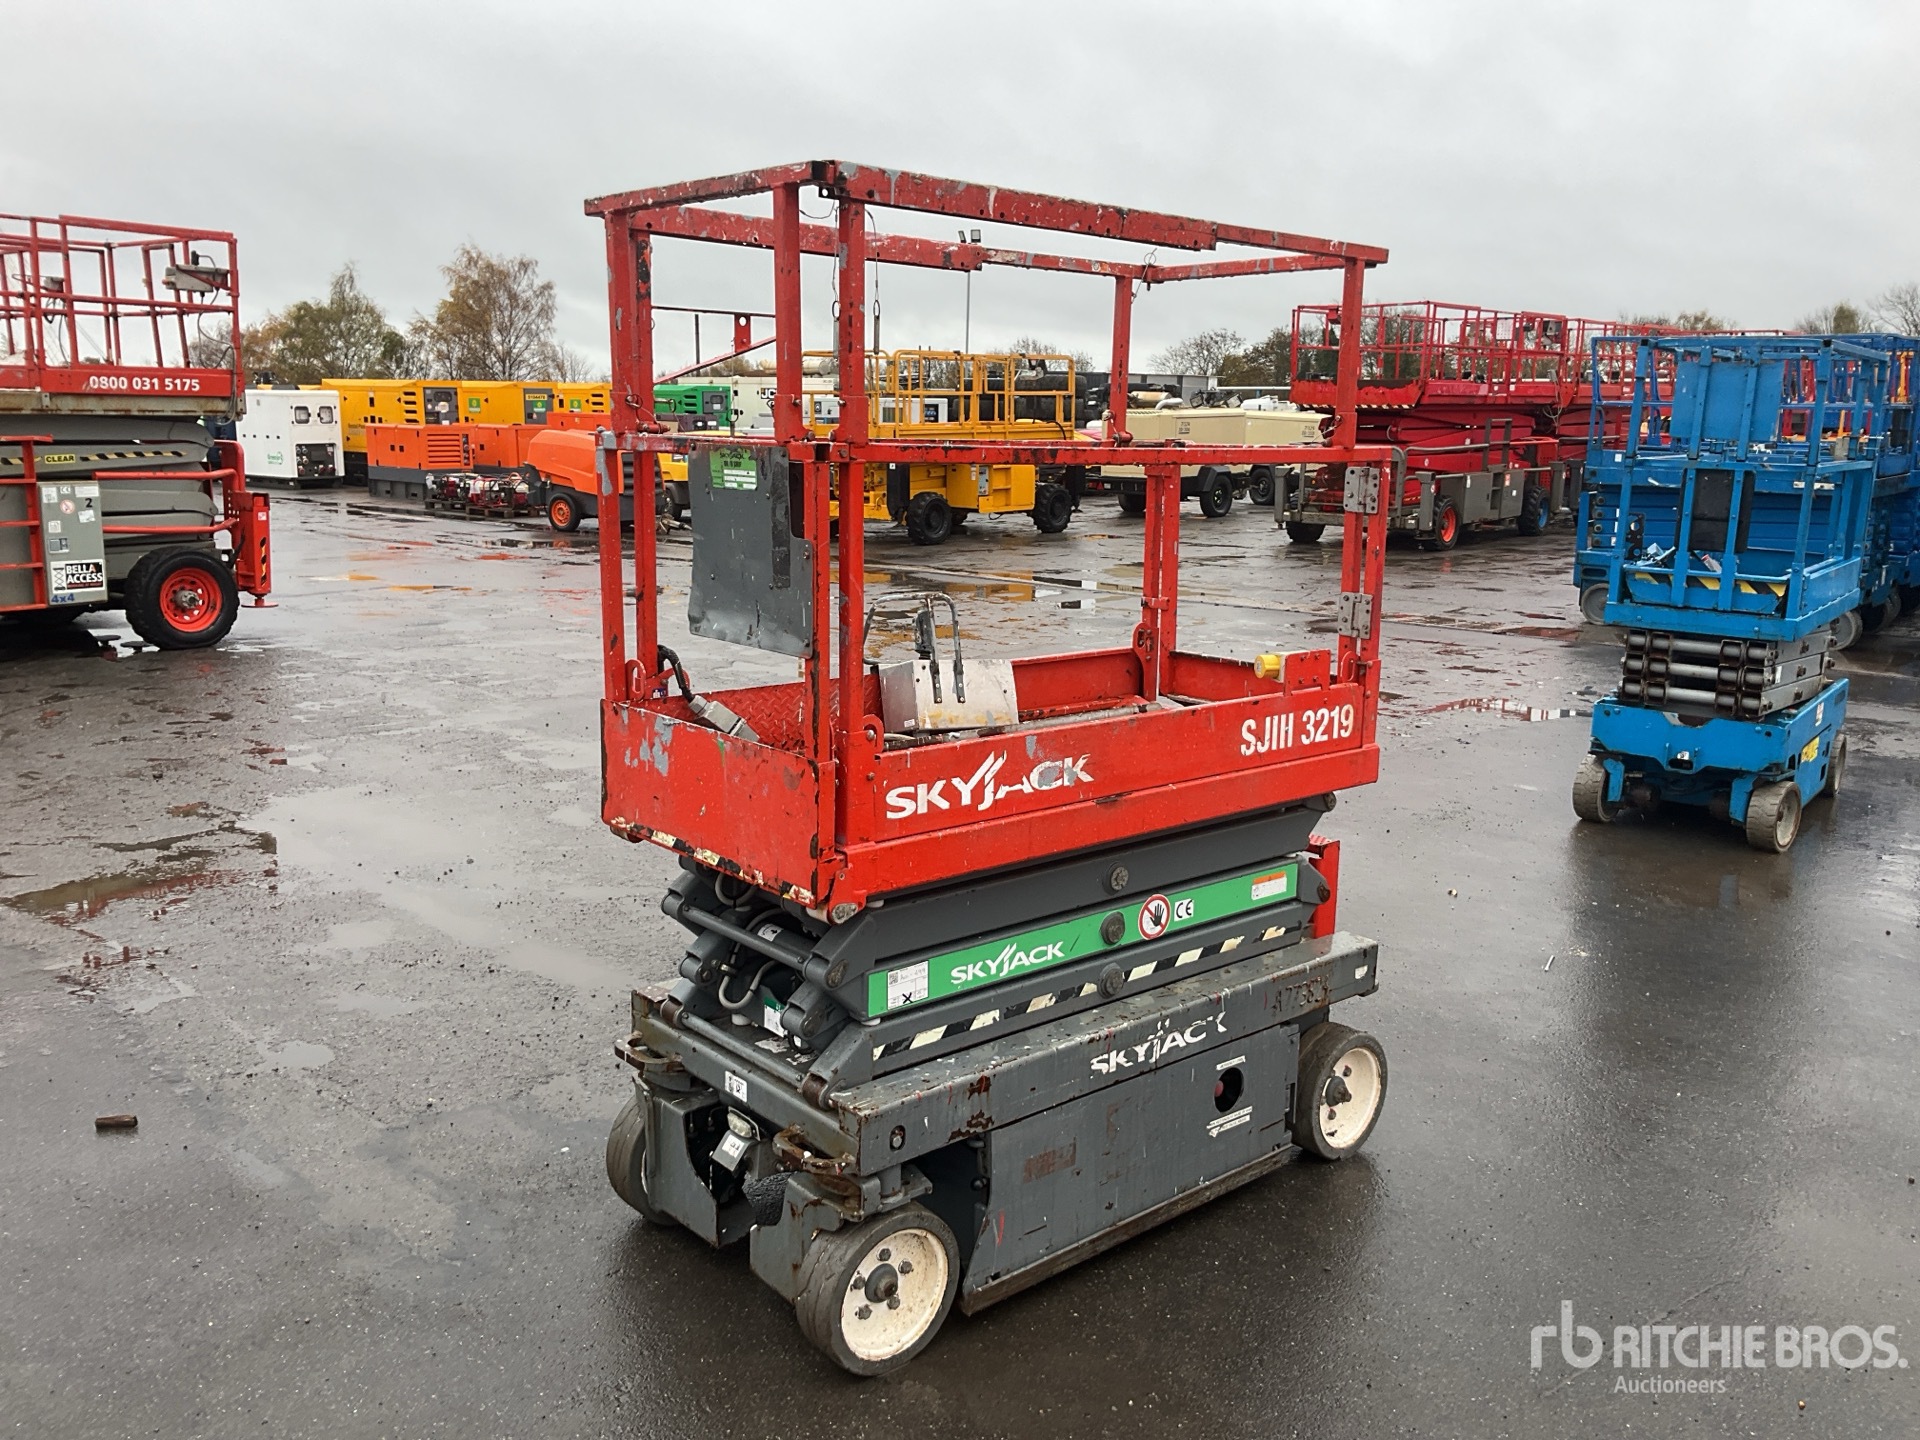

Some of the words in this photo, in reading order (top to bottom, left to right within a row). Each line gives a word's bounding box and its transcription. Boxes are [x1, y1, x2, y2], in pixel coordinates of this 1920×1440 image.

[89, 375, 128, 389] 0800
[132, 377, 159, 390] 031
[164, 378, 200, 391] 5175
[761, 388, 777, 399] JC
[45, 455, 75, 463] CLEAR
[84, 497, 93, 508] 2
[66, 563, 97, 574] BELLA
[66, 572, 104, 583] ACCESS
[1301, 704, 1354, 745] 3219
[885, 750, 1095, 819] SKYJACK
[950, 941, 1066, 985] SKYJACK
